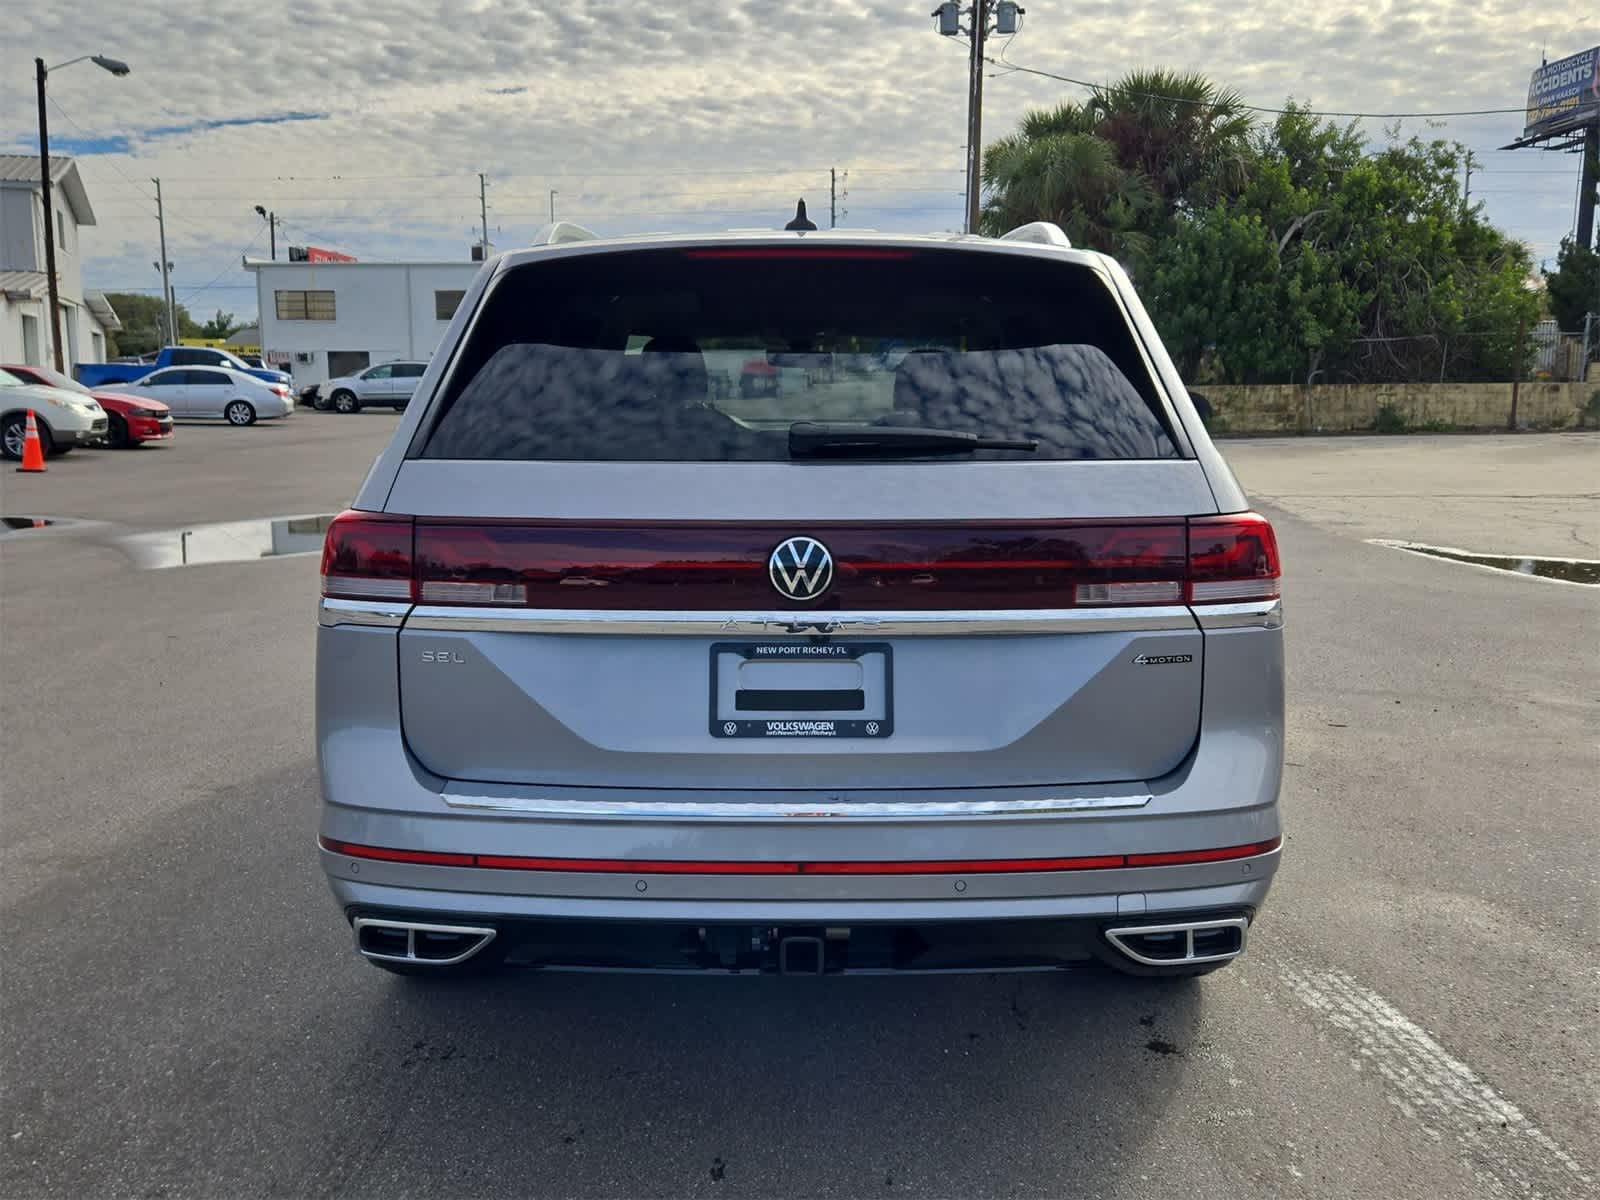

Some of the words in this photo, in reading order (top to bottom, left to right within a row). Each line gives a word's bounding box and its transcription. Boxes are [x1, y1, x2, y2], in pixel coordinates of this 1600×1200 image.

[1547, 51, 1594, 76] MOTORCYCLE
[1529, 63, 1593, 97] ACCIDENTS
[422, 651, 465, 663] SEL
[756, 646, 777, 655] NEW
[778, 646, 801, 655] PORT
[802, 646, 835, 656] RICHEY,
[836, 646, 847, 655] FL
[767, 721, 834, 731] VOLKSWAGEN
